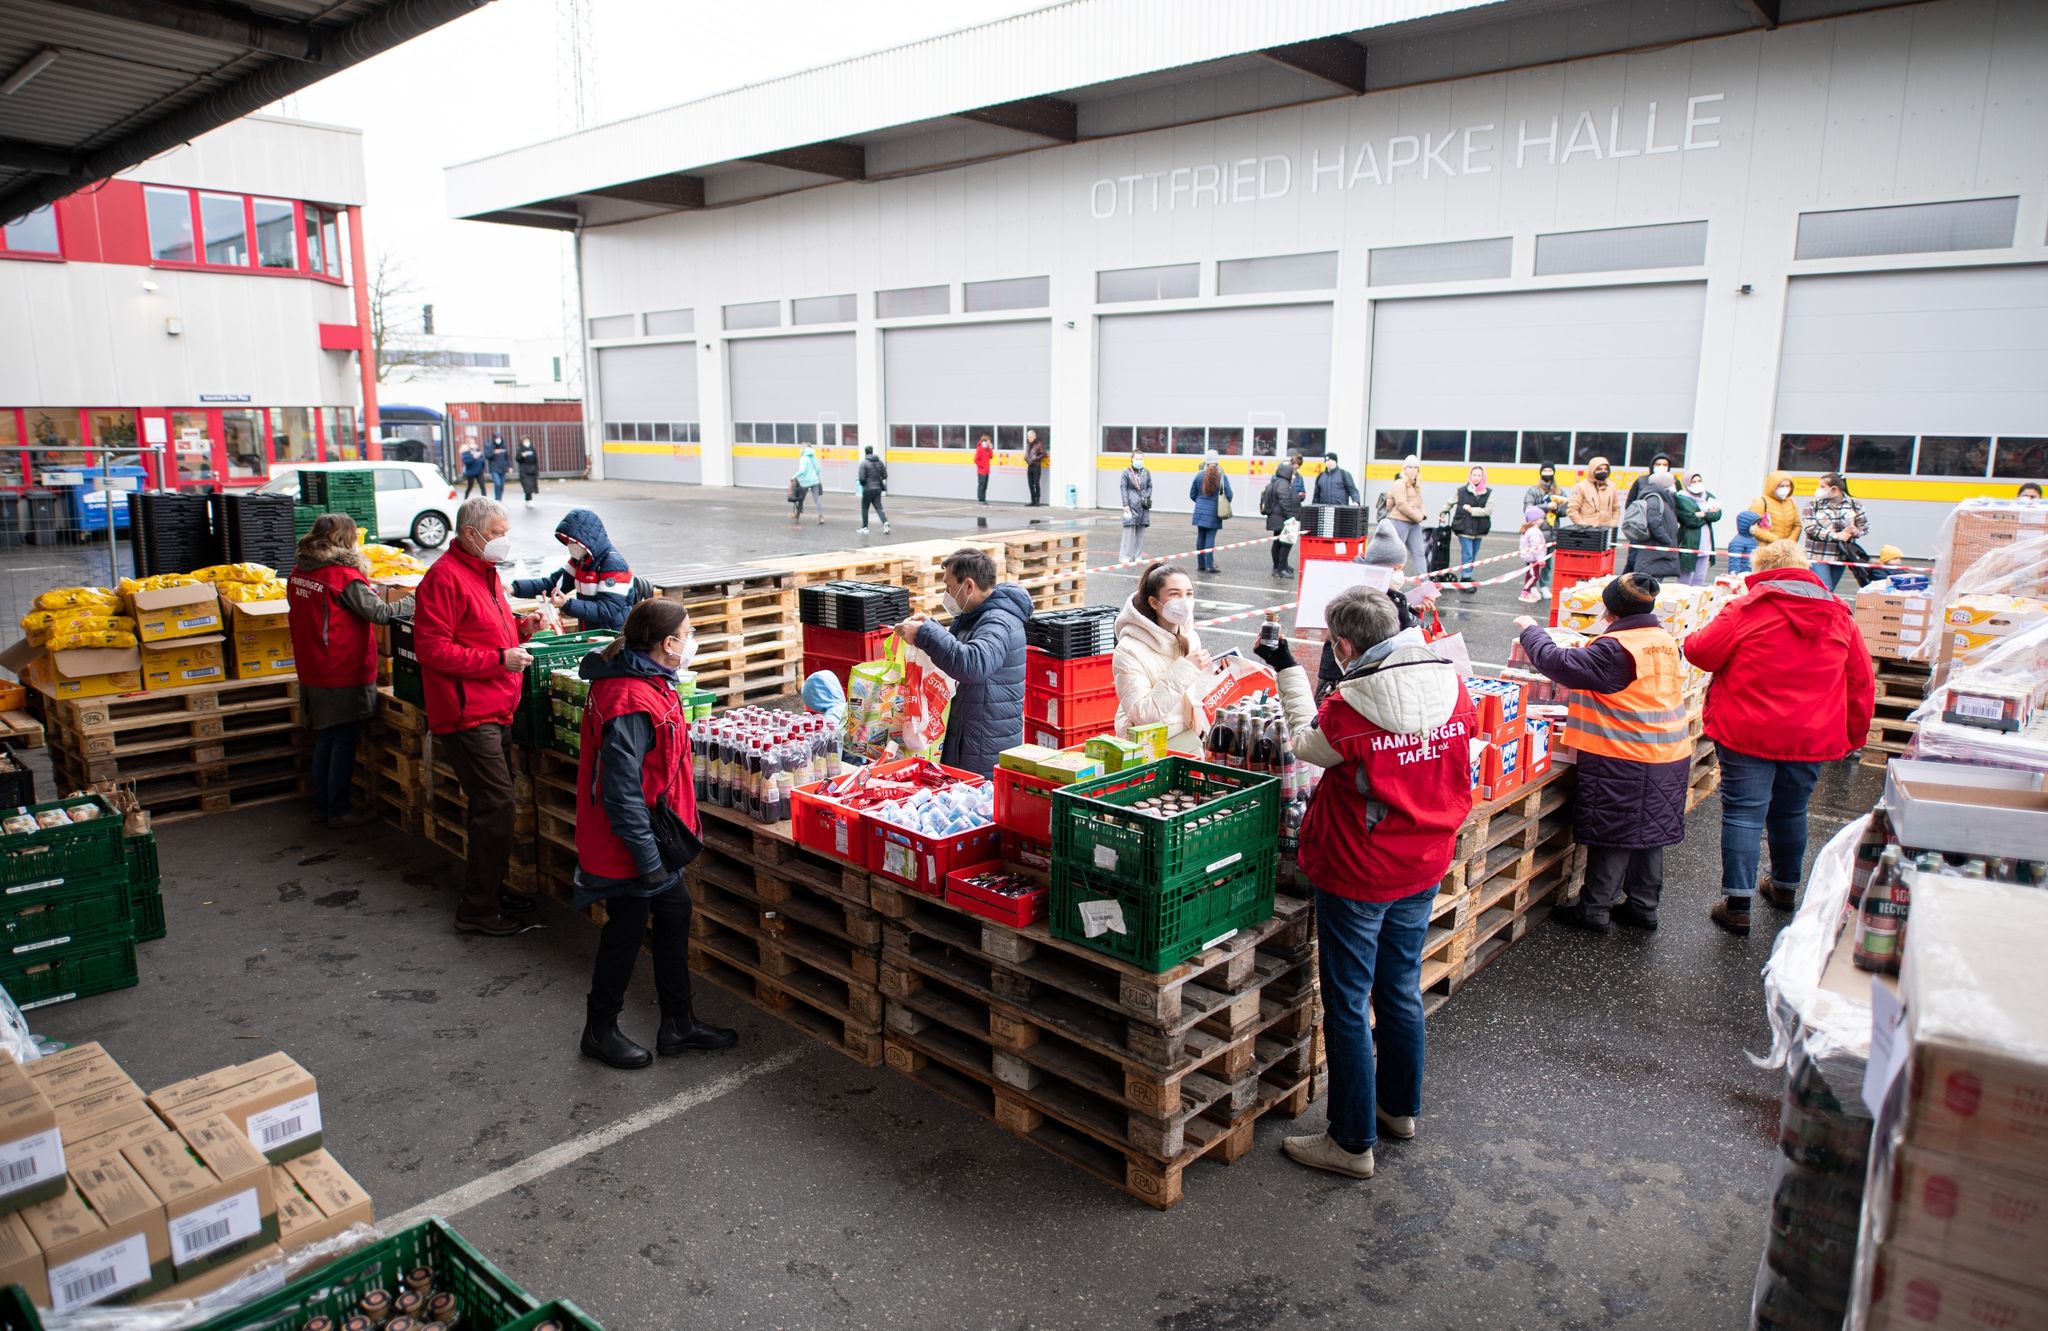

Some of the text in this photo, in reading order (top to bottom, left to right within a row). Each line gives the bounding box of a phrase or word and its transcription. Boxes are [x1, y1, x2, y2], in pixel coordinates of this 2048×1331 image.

[1091, 93, 1725, 220] OTTFRIED HAPKE HALLE
[1205, 679, 1235, 708] STAPLES
[1134, 1172, 1155, 1192] EPAL
